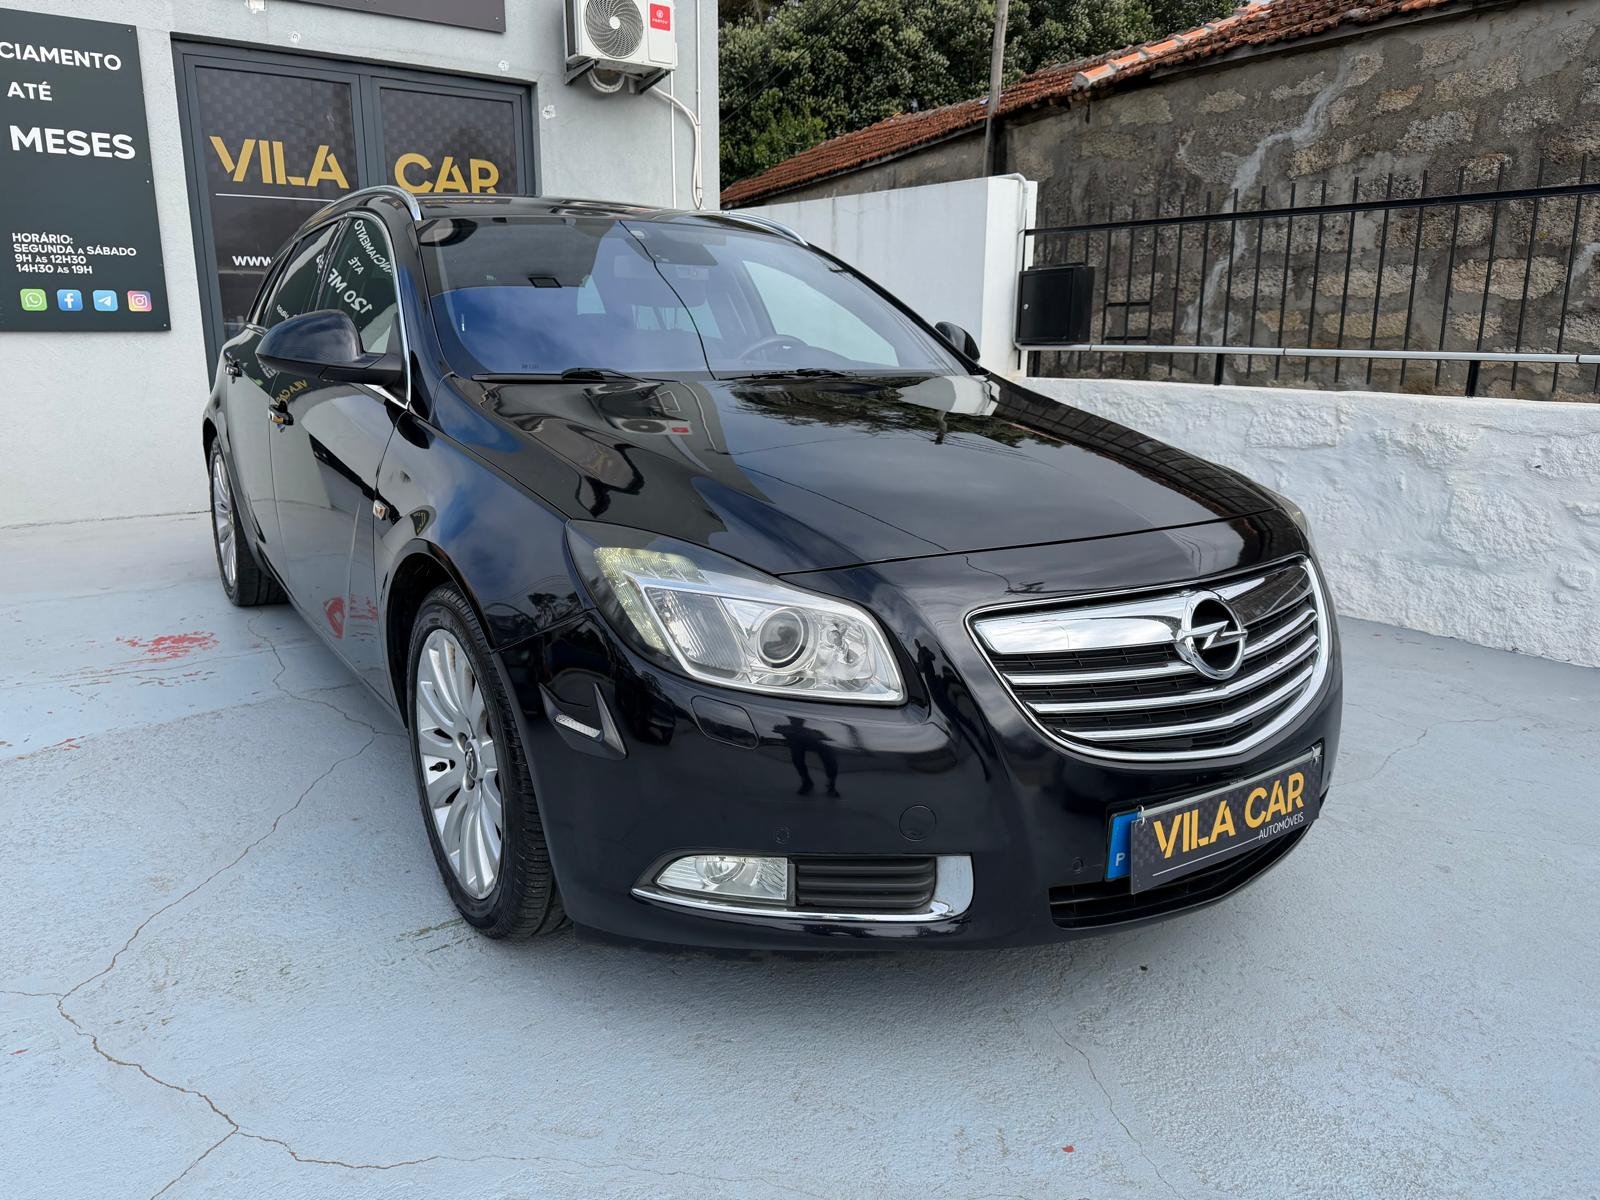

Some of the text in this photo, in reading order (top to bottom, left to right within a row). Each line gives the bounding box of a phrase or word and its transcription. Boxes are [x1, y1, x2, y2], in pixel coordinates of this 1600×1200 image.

[0, 41, 122, 71] CIAMENTO
[7, 81, 53, 101] ATÉ
[9, 125, 136, 160] MESES
[209, 136, 499, 194] VILA CAR
[12, 232, 73, 244] HORÁRIO:
[13, 243, 75, 254] SEGUNDA
[86, 245, 137, 256] SÁBADO
[15, 254, 32, 263] 9H
[51, 255, 87, 264] 12H30
[16, 264, 54, 273] 14H30
[71, 265, 93, 274] 19H
[1153, 772, 1305, 859] VILA CAR
[1258, 811, 1304, 839] AUTOMÓVEIS
[1115, 852, 1126, 867] P
